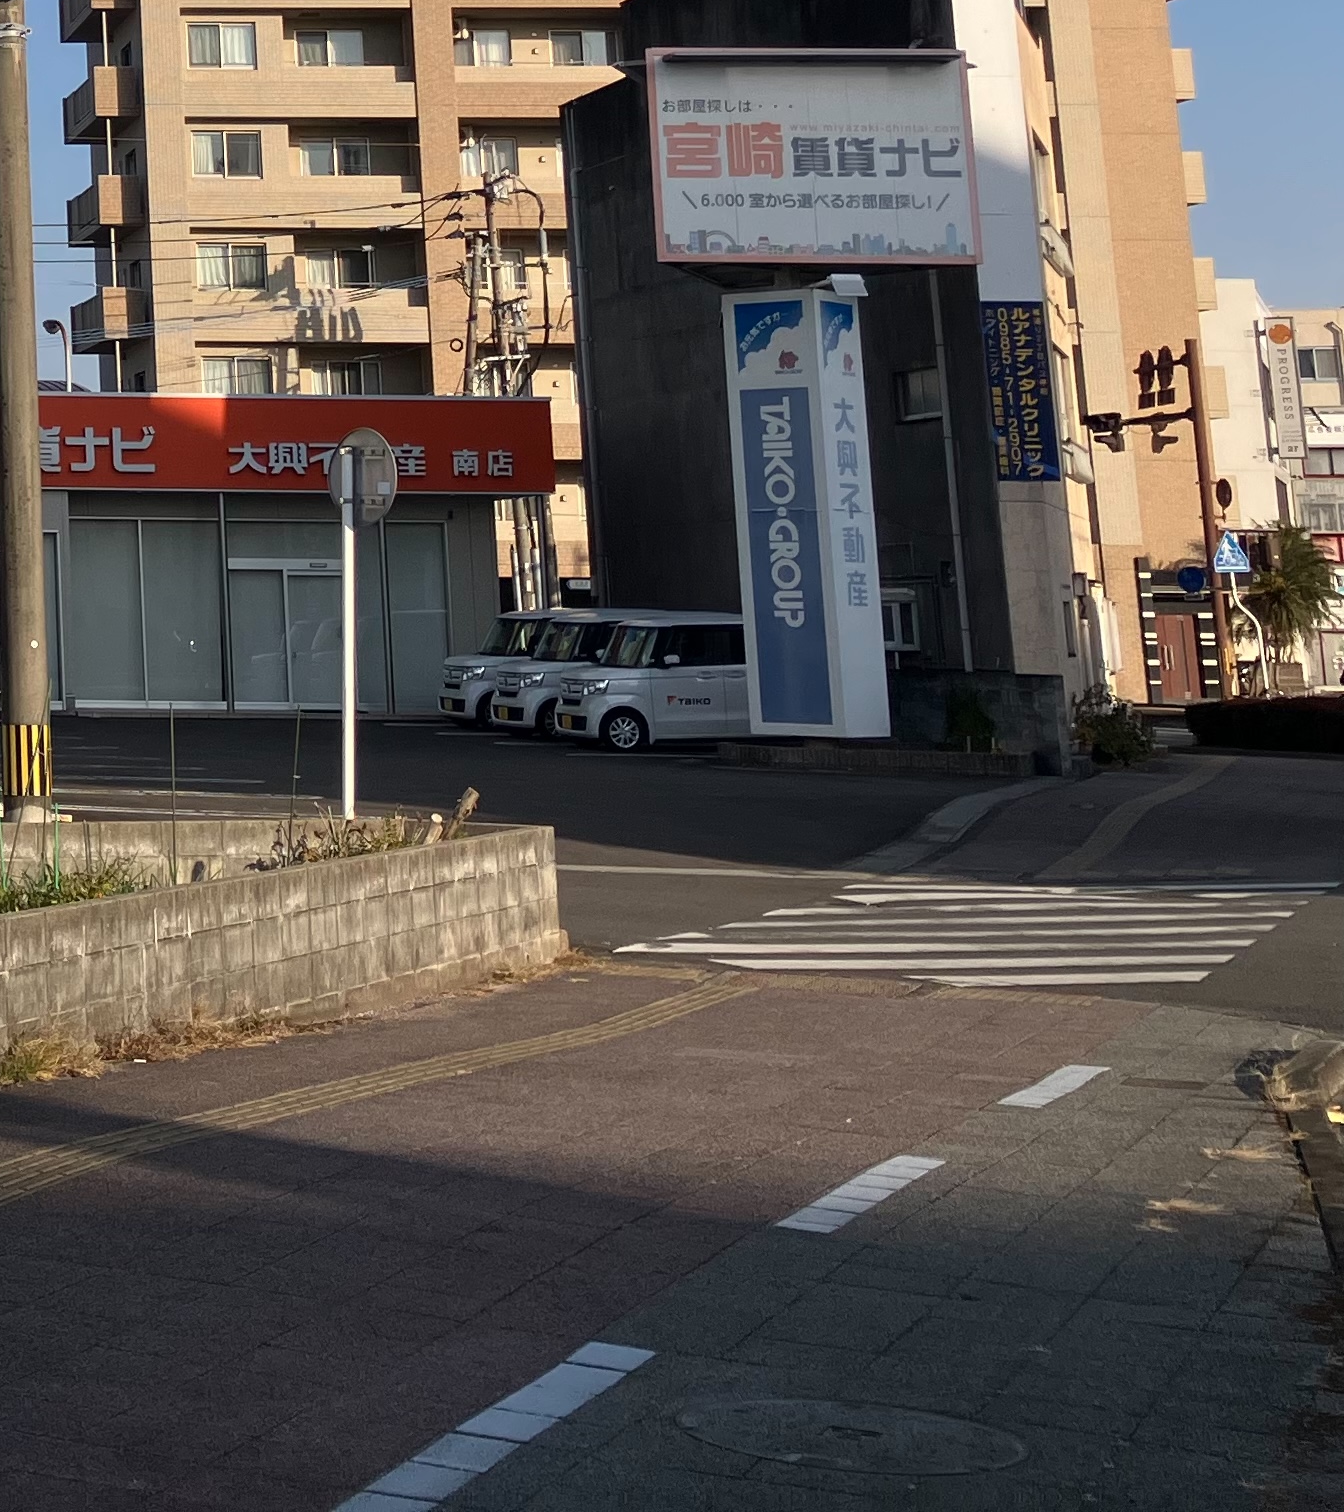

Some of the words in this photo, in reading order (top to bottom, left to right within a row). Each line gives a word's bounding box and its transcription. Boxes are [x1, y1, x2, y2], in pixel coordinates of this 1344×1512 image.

[1276, 348, 1294, 420] PROGRESS
[452, 449, 514, 477] 南店
[833, 396, 869, 608] 大興不動産
